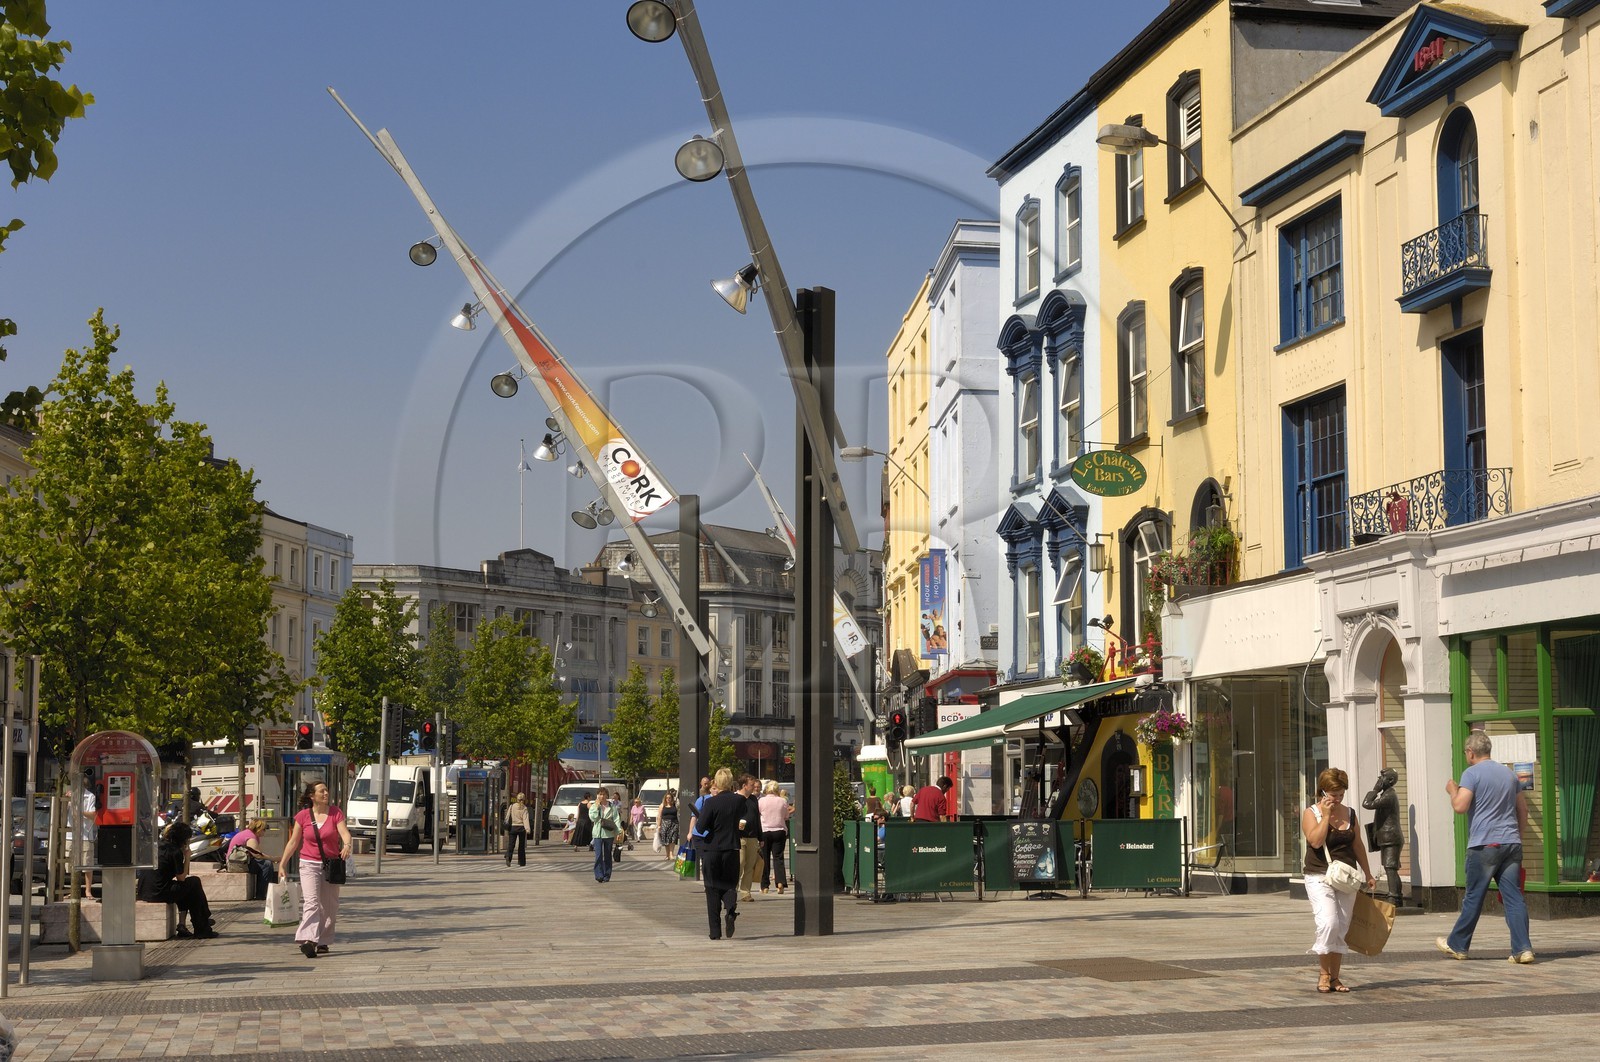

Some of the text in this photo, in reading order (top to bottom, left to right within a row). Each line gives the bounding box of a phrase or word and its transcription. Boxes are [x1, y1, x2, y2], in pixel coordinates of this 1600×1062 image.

[553, 376, 601, 437] www.corkfestival.com
[1073, 452, 1143, 481] Le Château
[1094, 467, 1125, 482] Bars
[1015, 843, 1044, 853] Coffee
